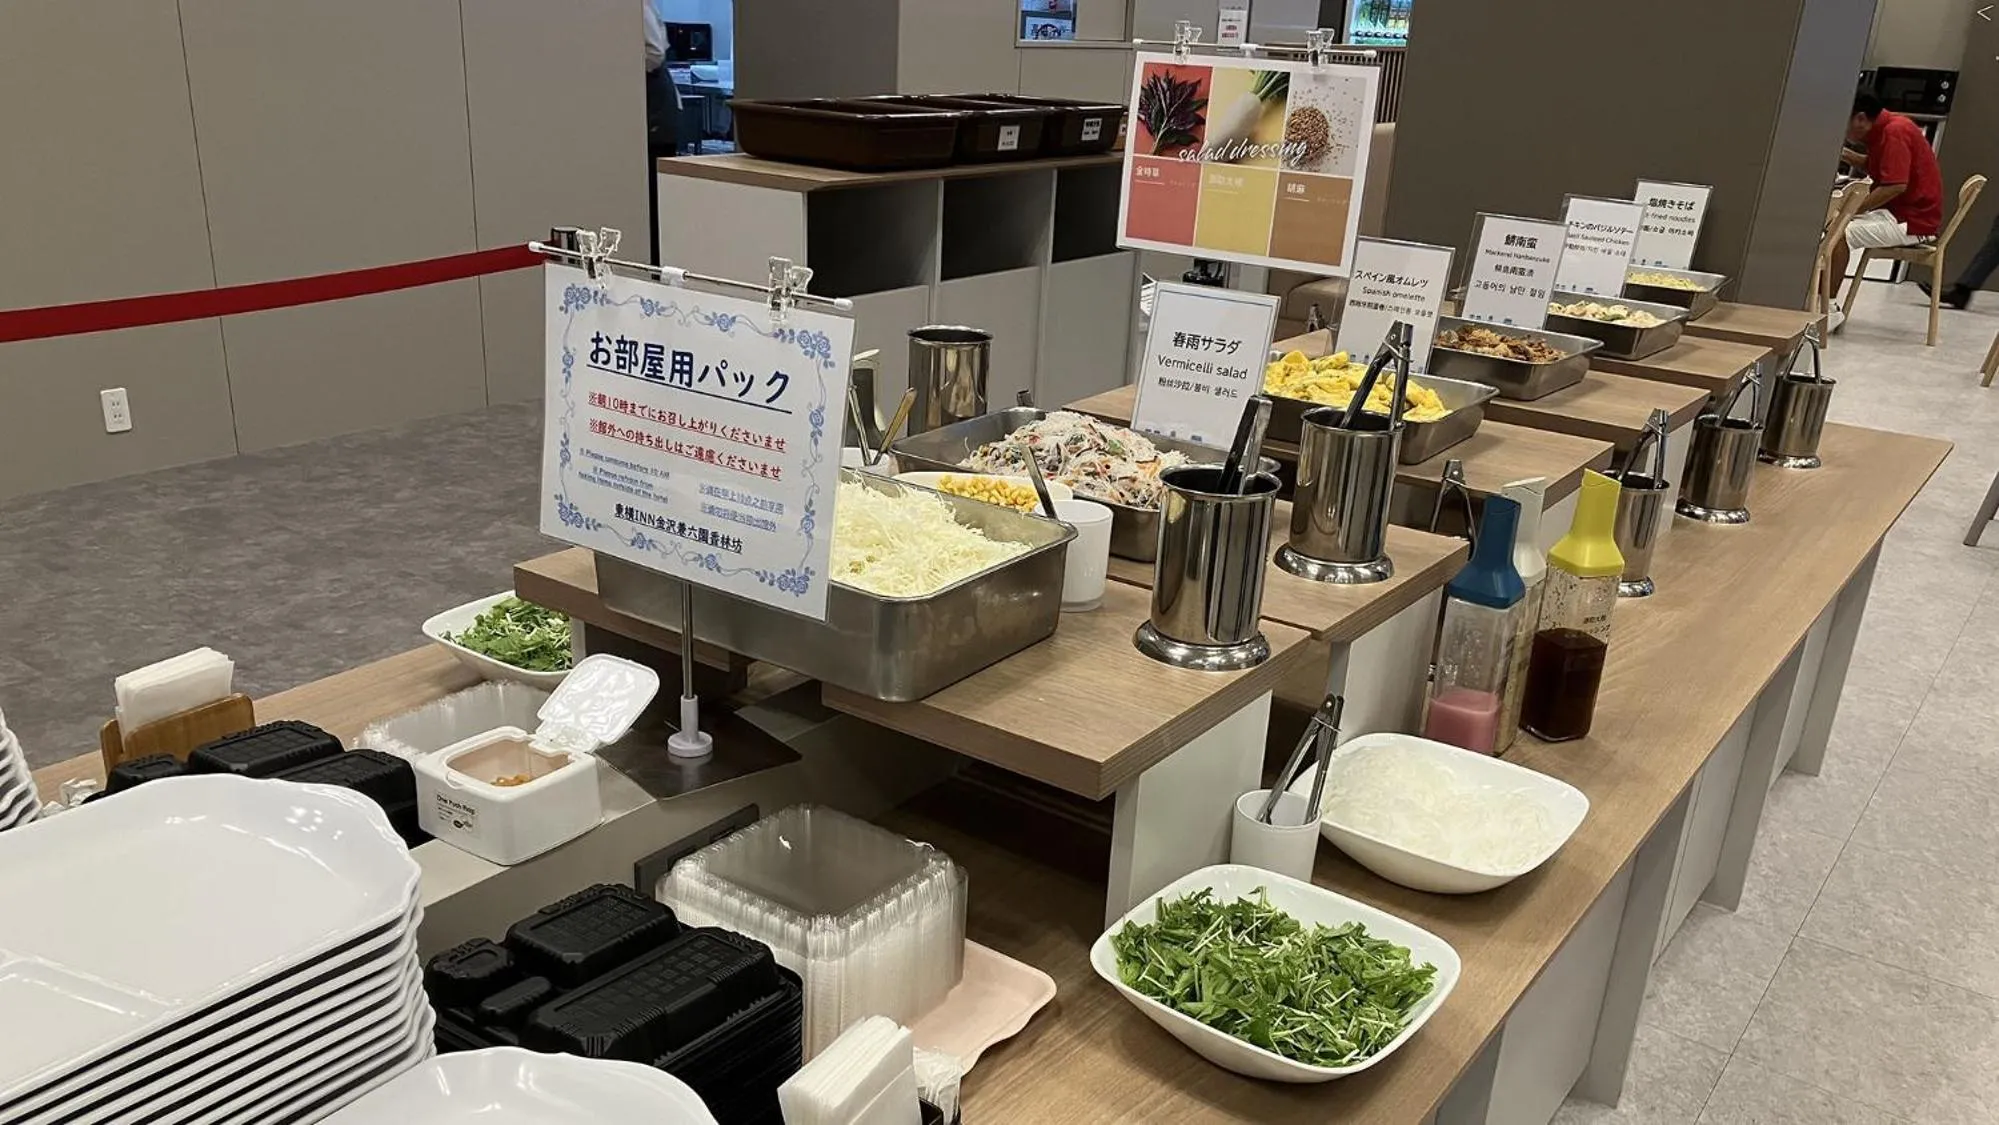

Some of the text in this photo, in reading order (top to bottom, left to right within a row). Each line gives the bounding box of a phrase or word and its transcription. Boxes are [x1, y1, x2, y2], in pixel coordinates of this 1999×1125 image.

[1179, 138, 1307, 168] salad dressing
[1354, 269, 1429, 289] スペイン風オムレツ
[1362, 286, 1426, 303] Spanish omelette
[1172, 330, 1242, 355] 春雨サラダ
[589, 330, 790, 404] お部屋用パック
[1158, 354, 1248, 380] Vermicelli salad
[588, 391, 787, 452] ※朝10時までにお召し上がりくださいませ
[589, 417, 783, 480] ※館外への持ち出しはご遠慮くださいませ
[614, 502, 743, 554] 東横INN金沢兼六園香林坊
